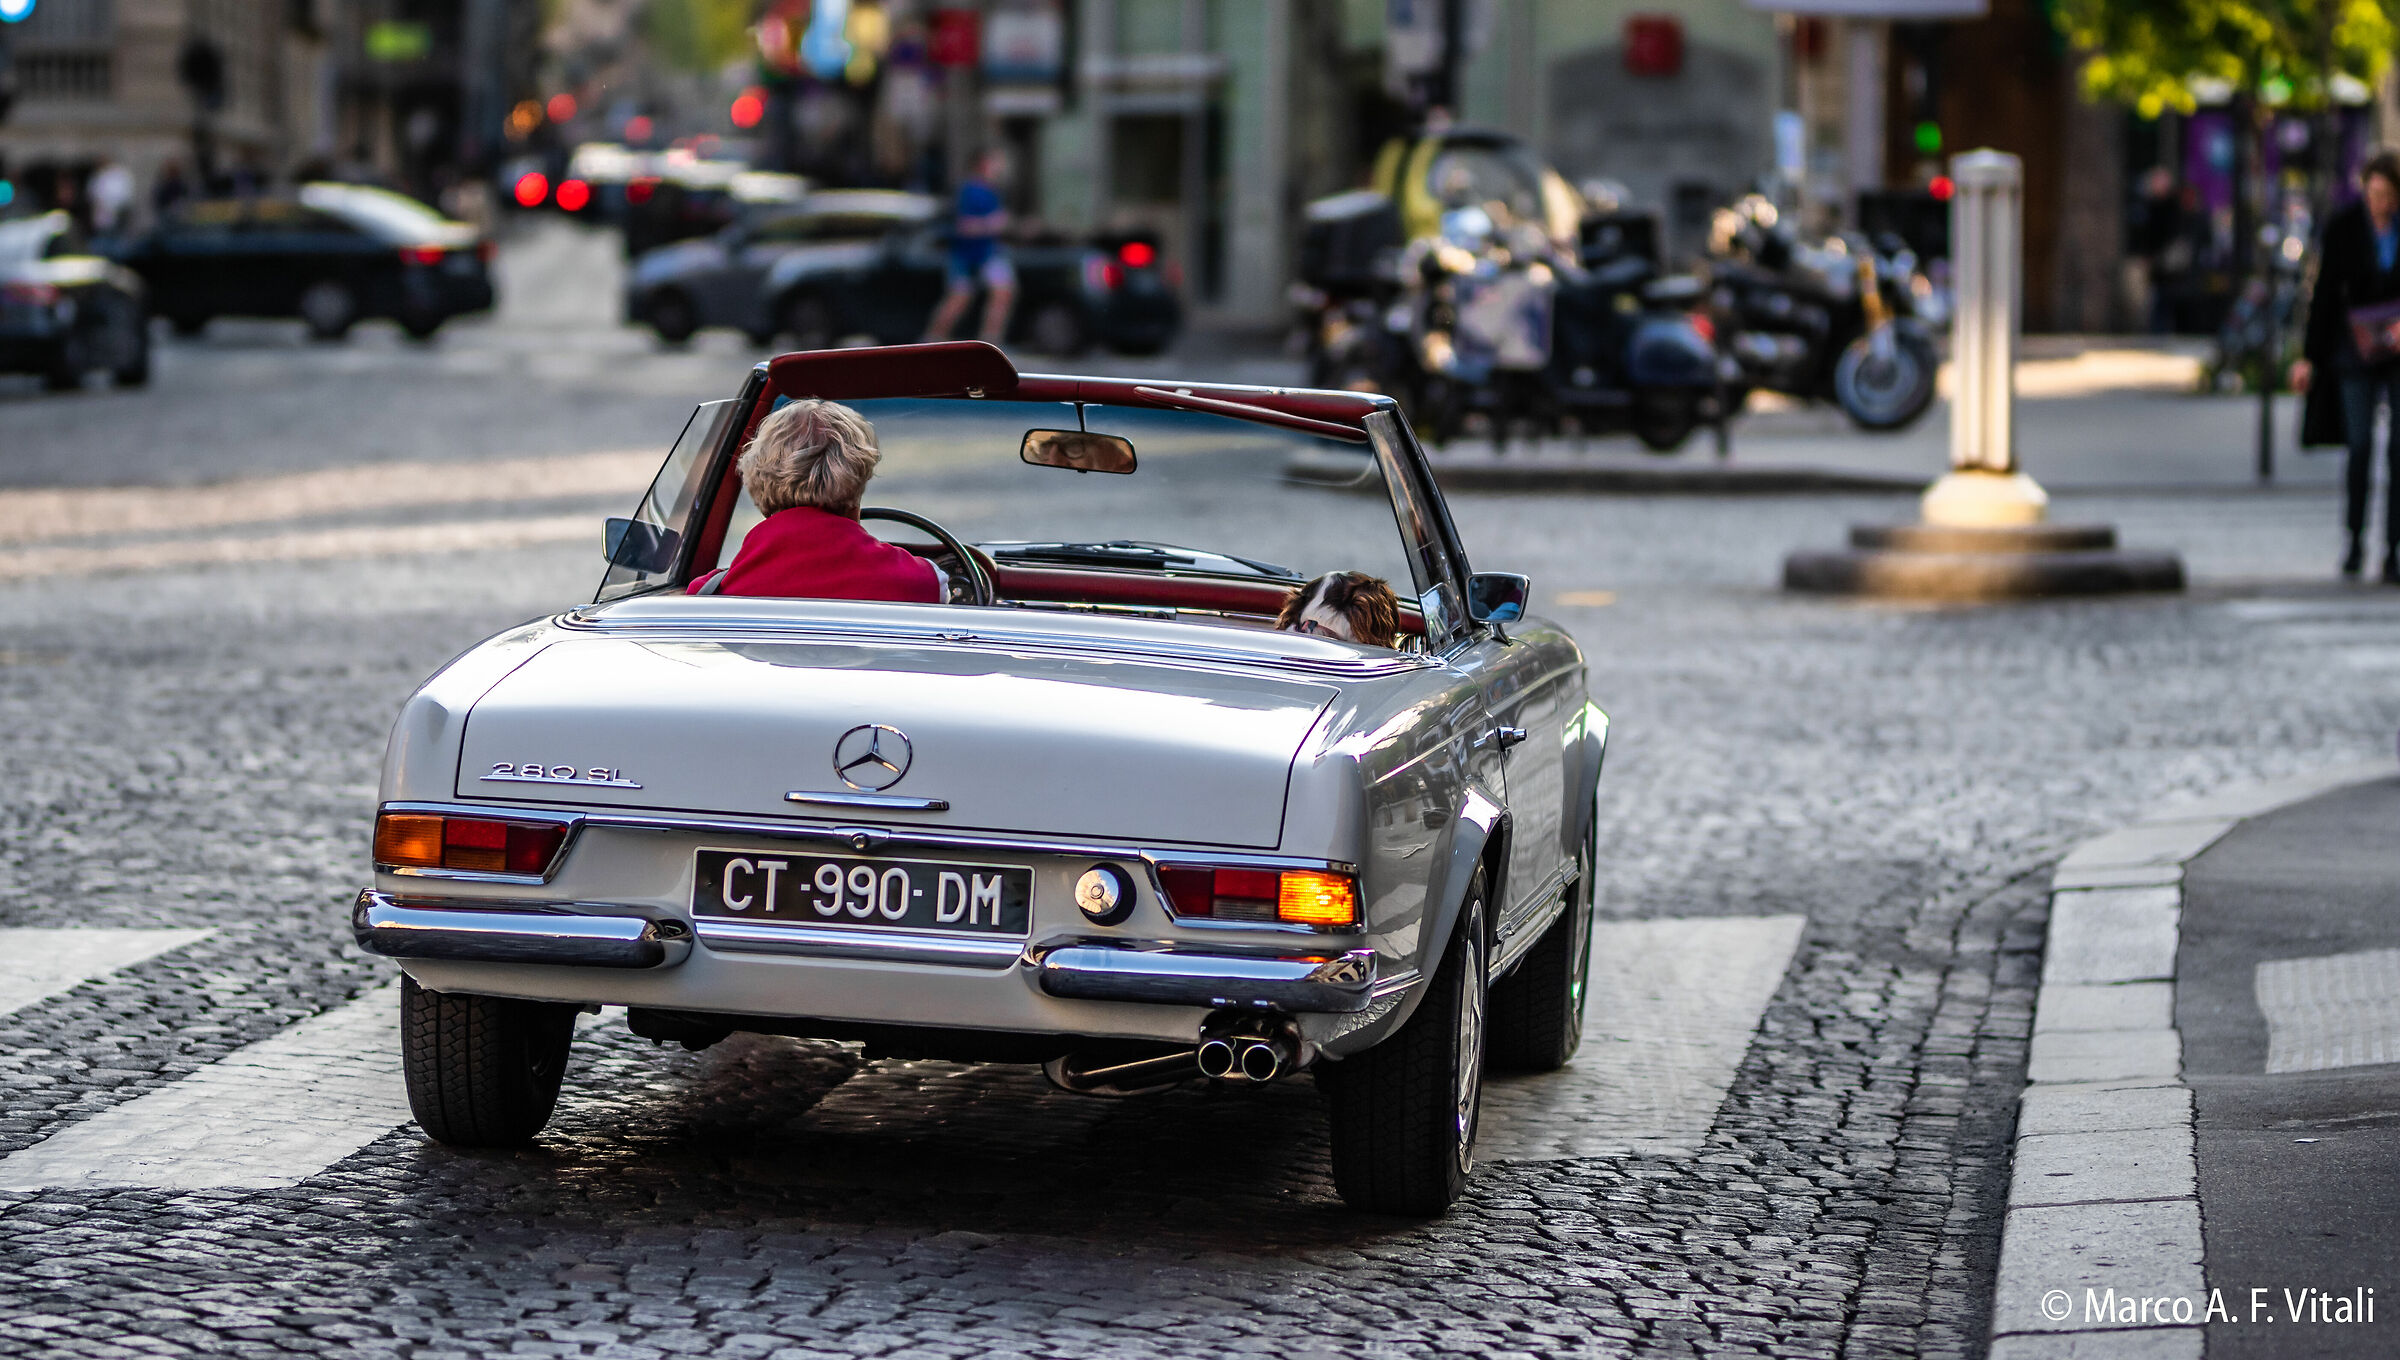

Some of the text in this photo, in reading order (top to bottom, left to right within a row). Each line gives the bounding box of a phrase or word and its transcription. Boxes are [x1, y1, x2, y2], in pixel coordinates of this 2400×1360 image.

[492, 762, 631, 783] 280 SL
[722, 858, 788, 911] CT
[936, 871, 1002, 926] DM
